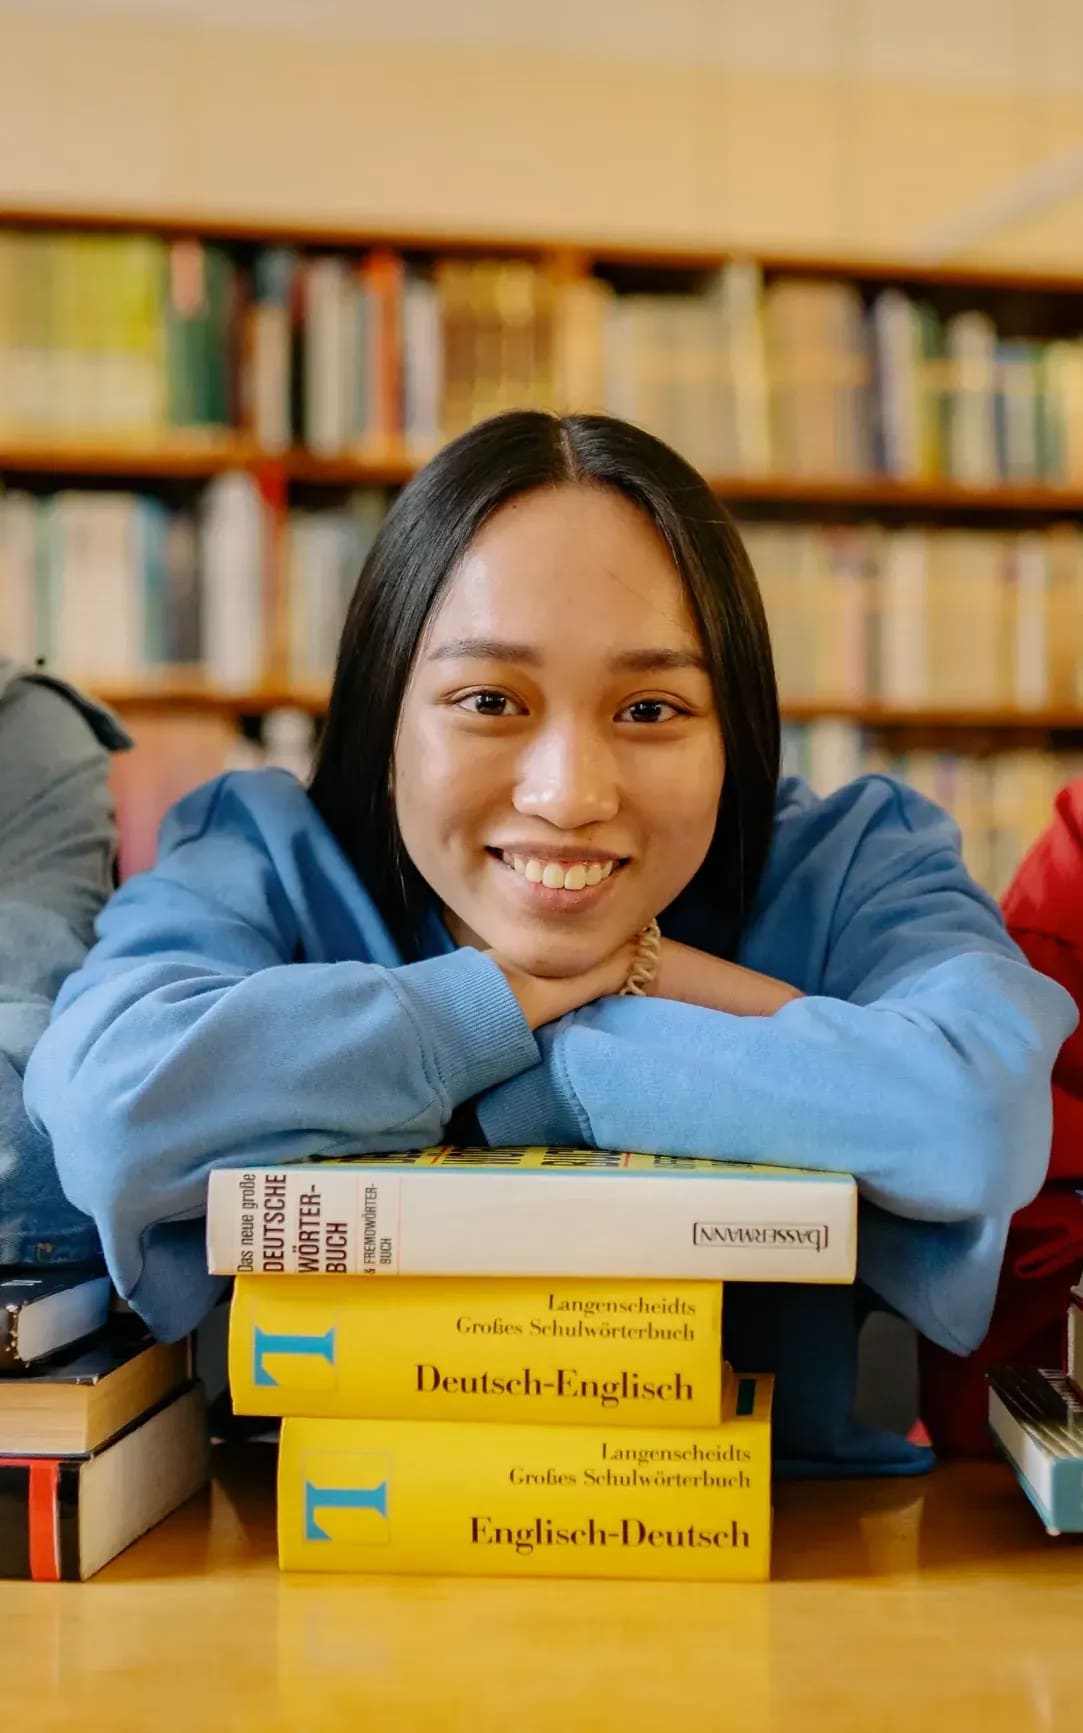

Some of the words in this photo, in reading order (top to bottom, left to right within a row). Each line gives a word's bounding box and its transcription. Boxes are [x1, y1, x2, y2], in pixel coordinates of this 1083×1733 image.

[239, 1173, 258, 1210] große
[241, 1214, 254, 1246] neue
[263, 1174, 287, 1272] DEUTSCHE
[292, 1184, 321, 1273] WÖRTER-
[361, 1183, 379, 1264] FREMDWÖRTER-
[237, 1250, 254, 1273] Das
[326, 1222, 348, 1273] BUCH
[380, 1238, 392, 1264] BUCH
[548, 1294, 696, 1317] Langenscheidts
[456, 1315, 523, 1336] Großes
[530, 1319, 695, 1342] Schulwörterbuch
[415, 1363, 694, 1409] Deutsch-Englisch
[602, 1442, 752, 1466] Langenscheidts
[509, 1467, 577, 1487] Großes
[583, 1468, 751, 1489] Schulwörterbuch
[470, 1516, 750, 1556] Englisch-Deutsch
